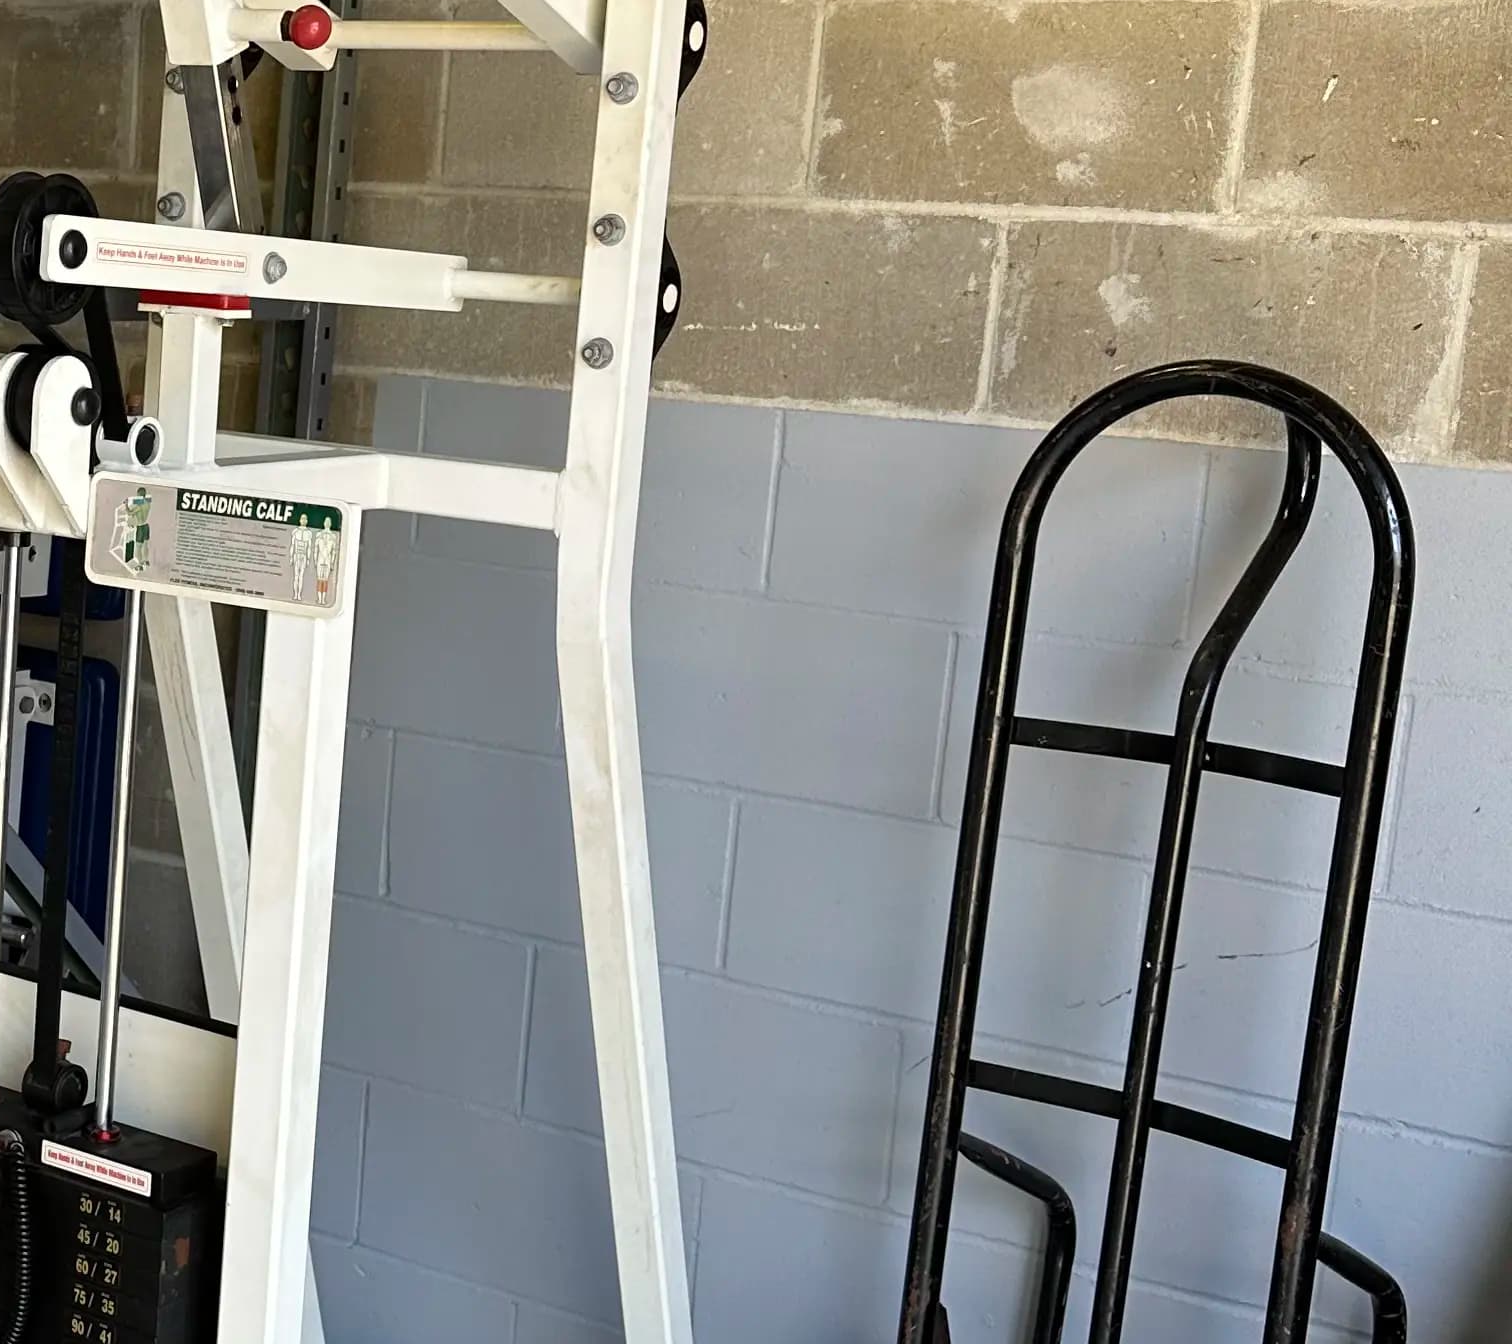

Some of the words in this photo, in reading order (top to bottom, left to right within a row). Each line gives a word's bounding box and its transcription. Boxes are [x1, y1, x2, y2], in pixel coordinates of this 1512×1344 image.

[98, 247, 115, 258] Keep
[116, 249, 136, 259] Hands
[159, 252, 175, 263] Away
[177, 253, 193, 264] While
[194, 256, 219, 266] Machine
[234, 261, 245, 269] Use
[181, 492, 254, 517] STANDING
[256, 502, 294, 522] CALF
[80, 1198, 92, 1213] 30
[109, 1208, 120, 1223] 14
[78, 1229, 90, 1244] 45
[107, 1238, 119, 1254] 20
[76, 1259, 88, 1274] 60
[104, 1269, 117, 1284] 27
[74, 1289, 85, 1304] 75
[102, 1299, 114, 1315] 35
[72, 1319, 84, 1335] 90
[100, 1330, 111, 1344] 41
